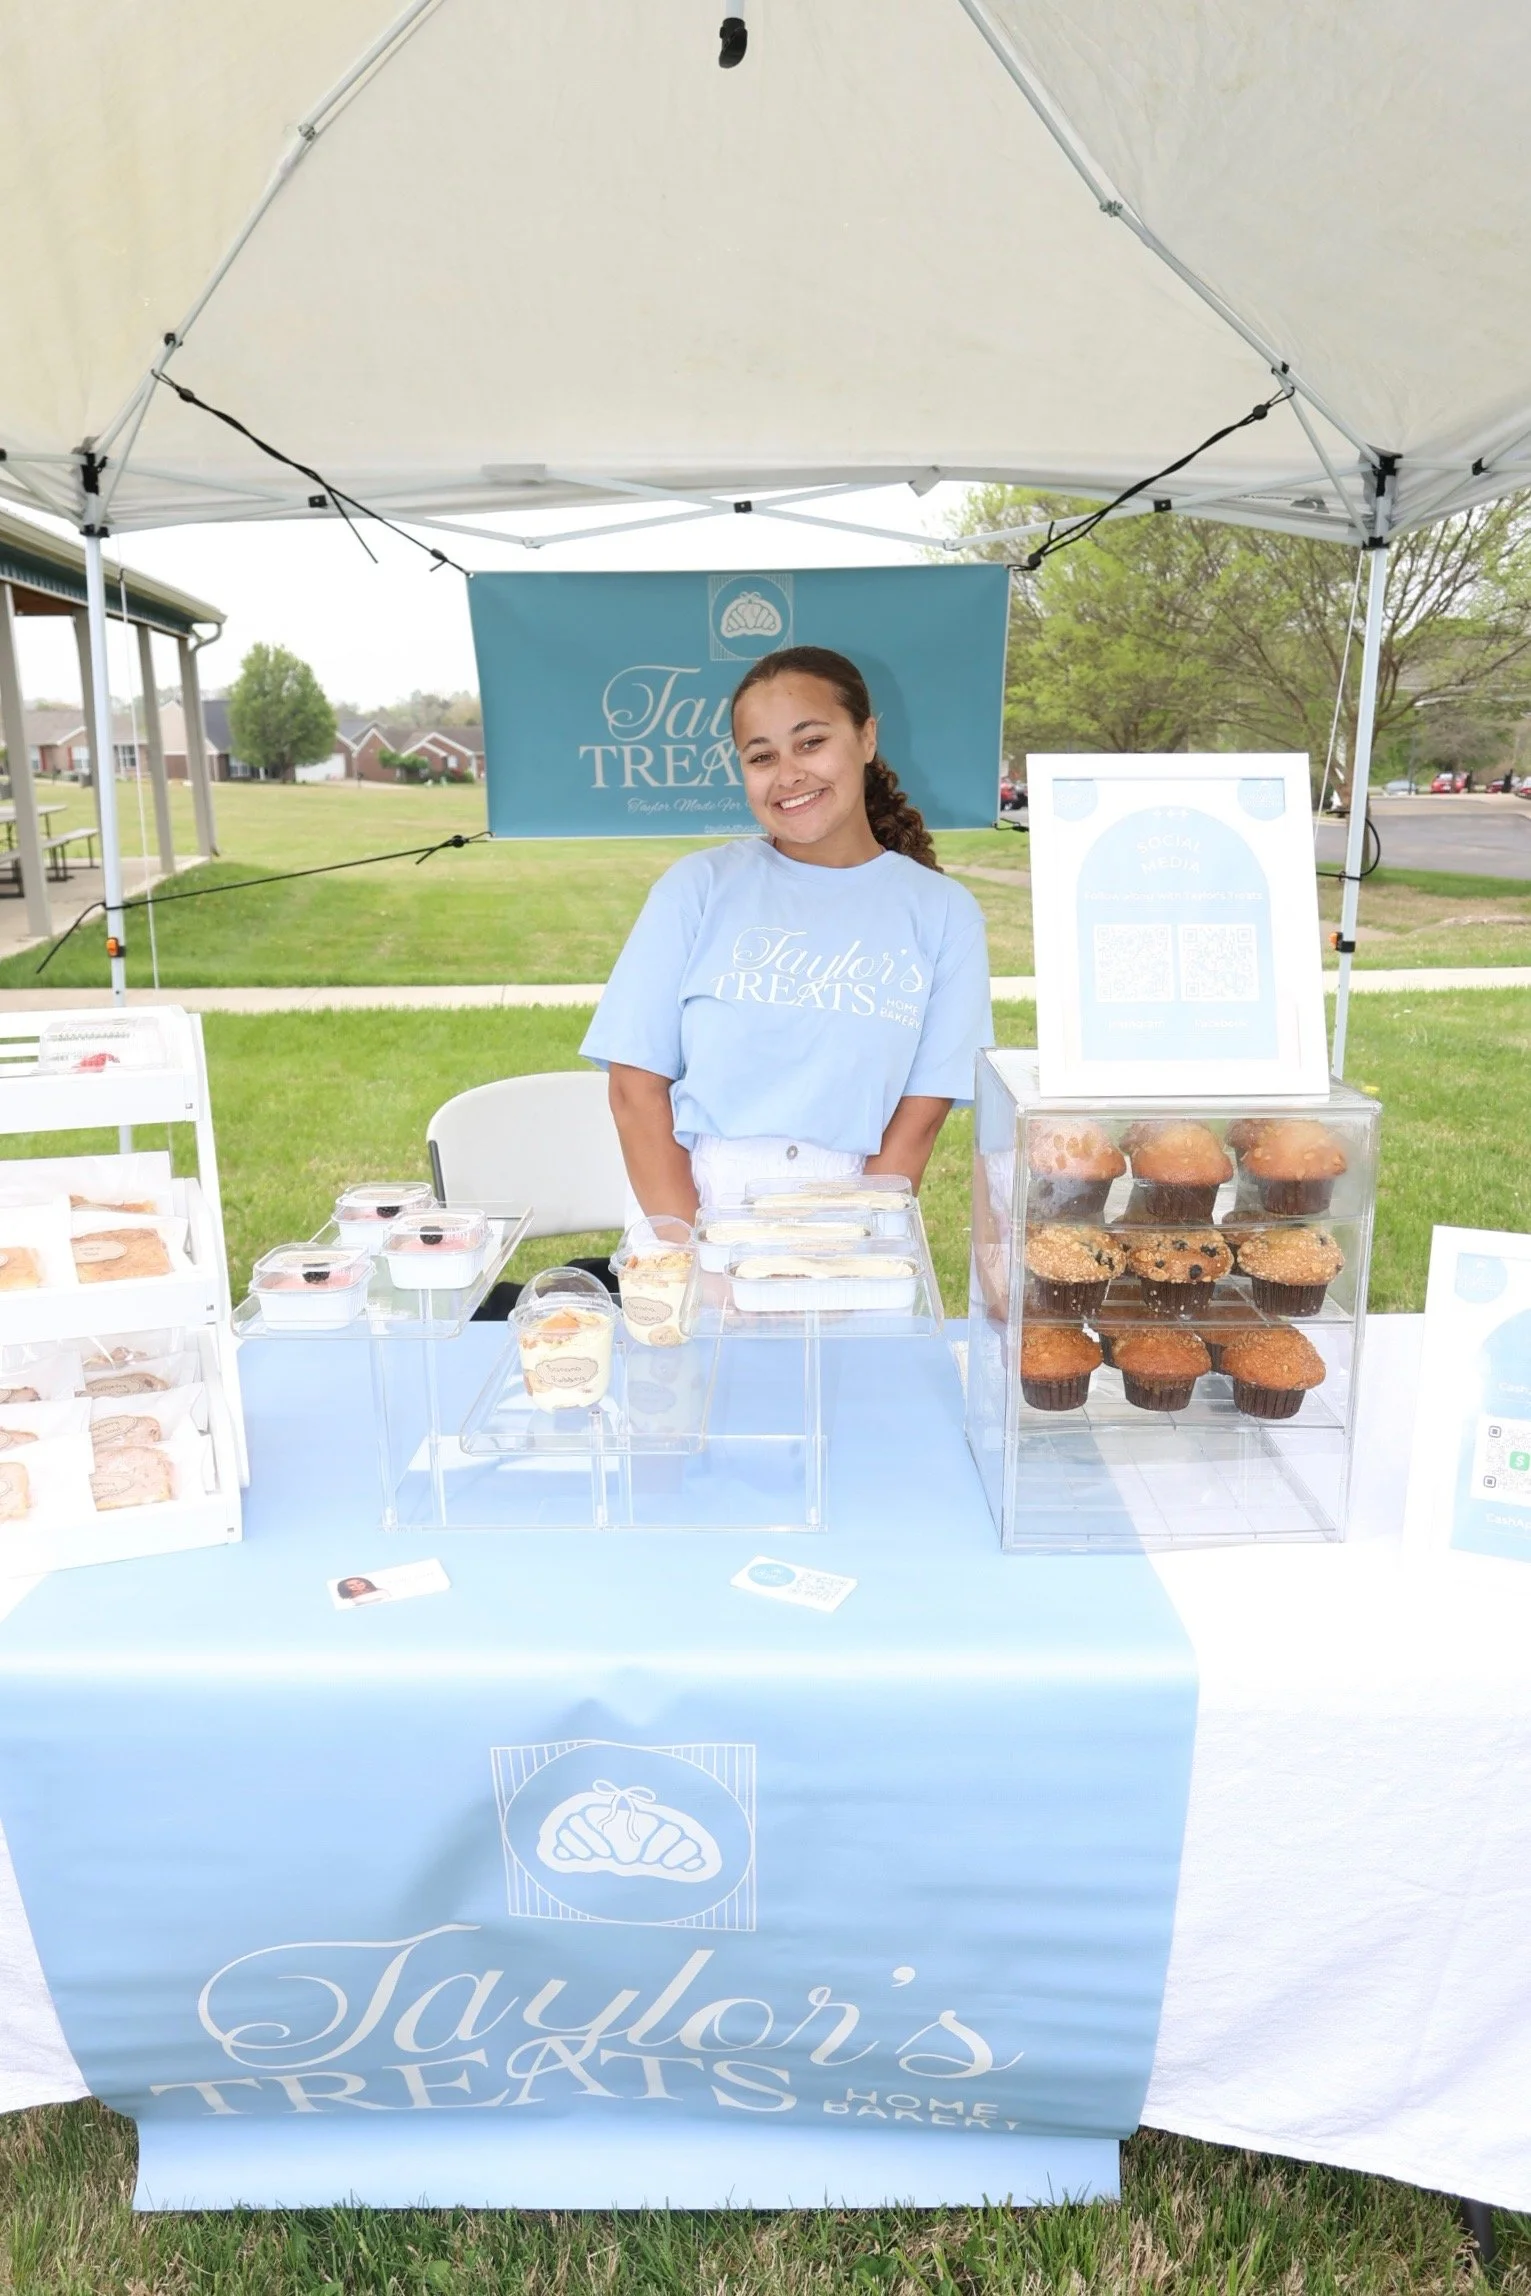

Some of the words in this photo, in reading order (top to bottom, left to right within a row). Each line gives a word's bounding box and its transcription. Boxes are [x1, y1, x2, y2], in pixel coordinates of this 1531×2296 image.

[579, 743, 743, 789] TREA
[627, 797, 671, 816] Taylor
[674, 797, 715, 813] Made
[716, 796, 741, 812] For
[1137, 834, 1200, 855] SOCIAL
[1141, 856, 1200, 875] MEDIA
[732, 926, 929, 994] Taylor's
[710, 970, 876, 1016] TREATS
[886, 998, 919, 1017] HOME
[879, 1006, 922, 1031] BAKERY
[197, 1923, 1025, 2079] Taylor's
[150, 2036, 798, 2116] TREATS
[846, 2087, 999, 2119] HOME
